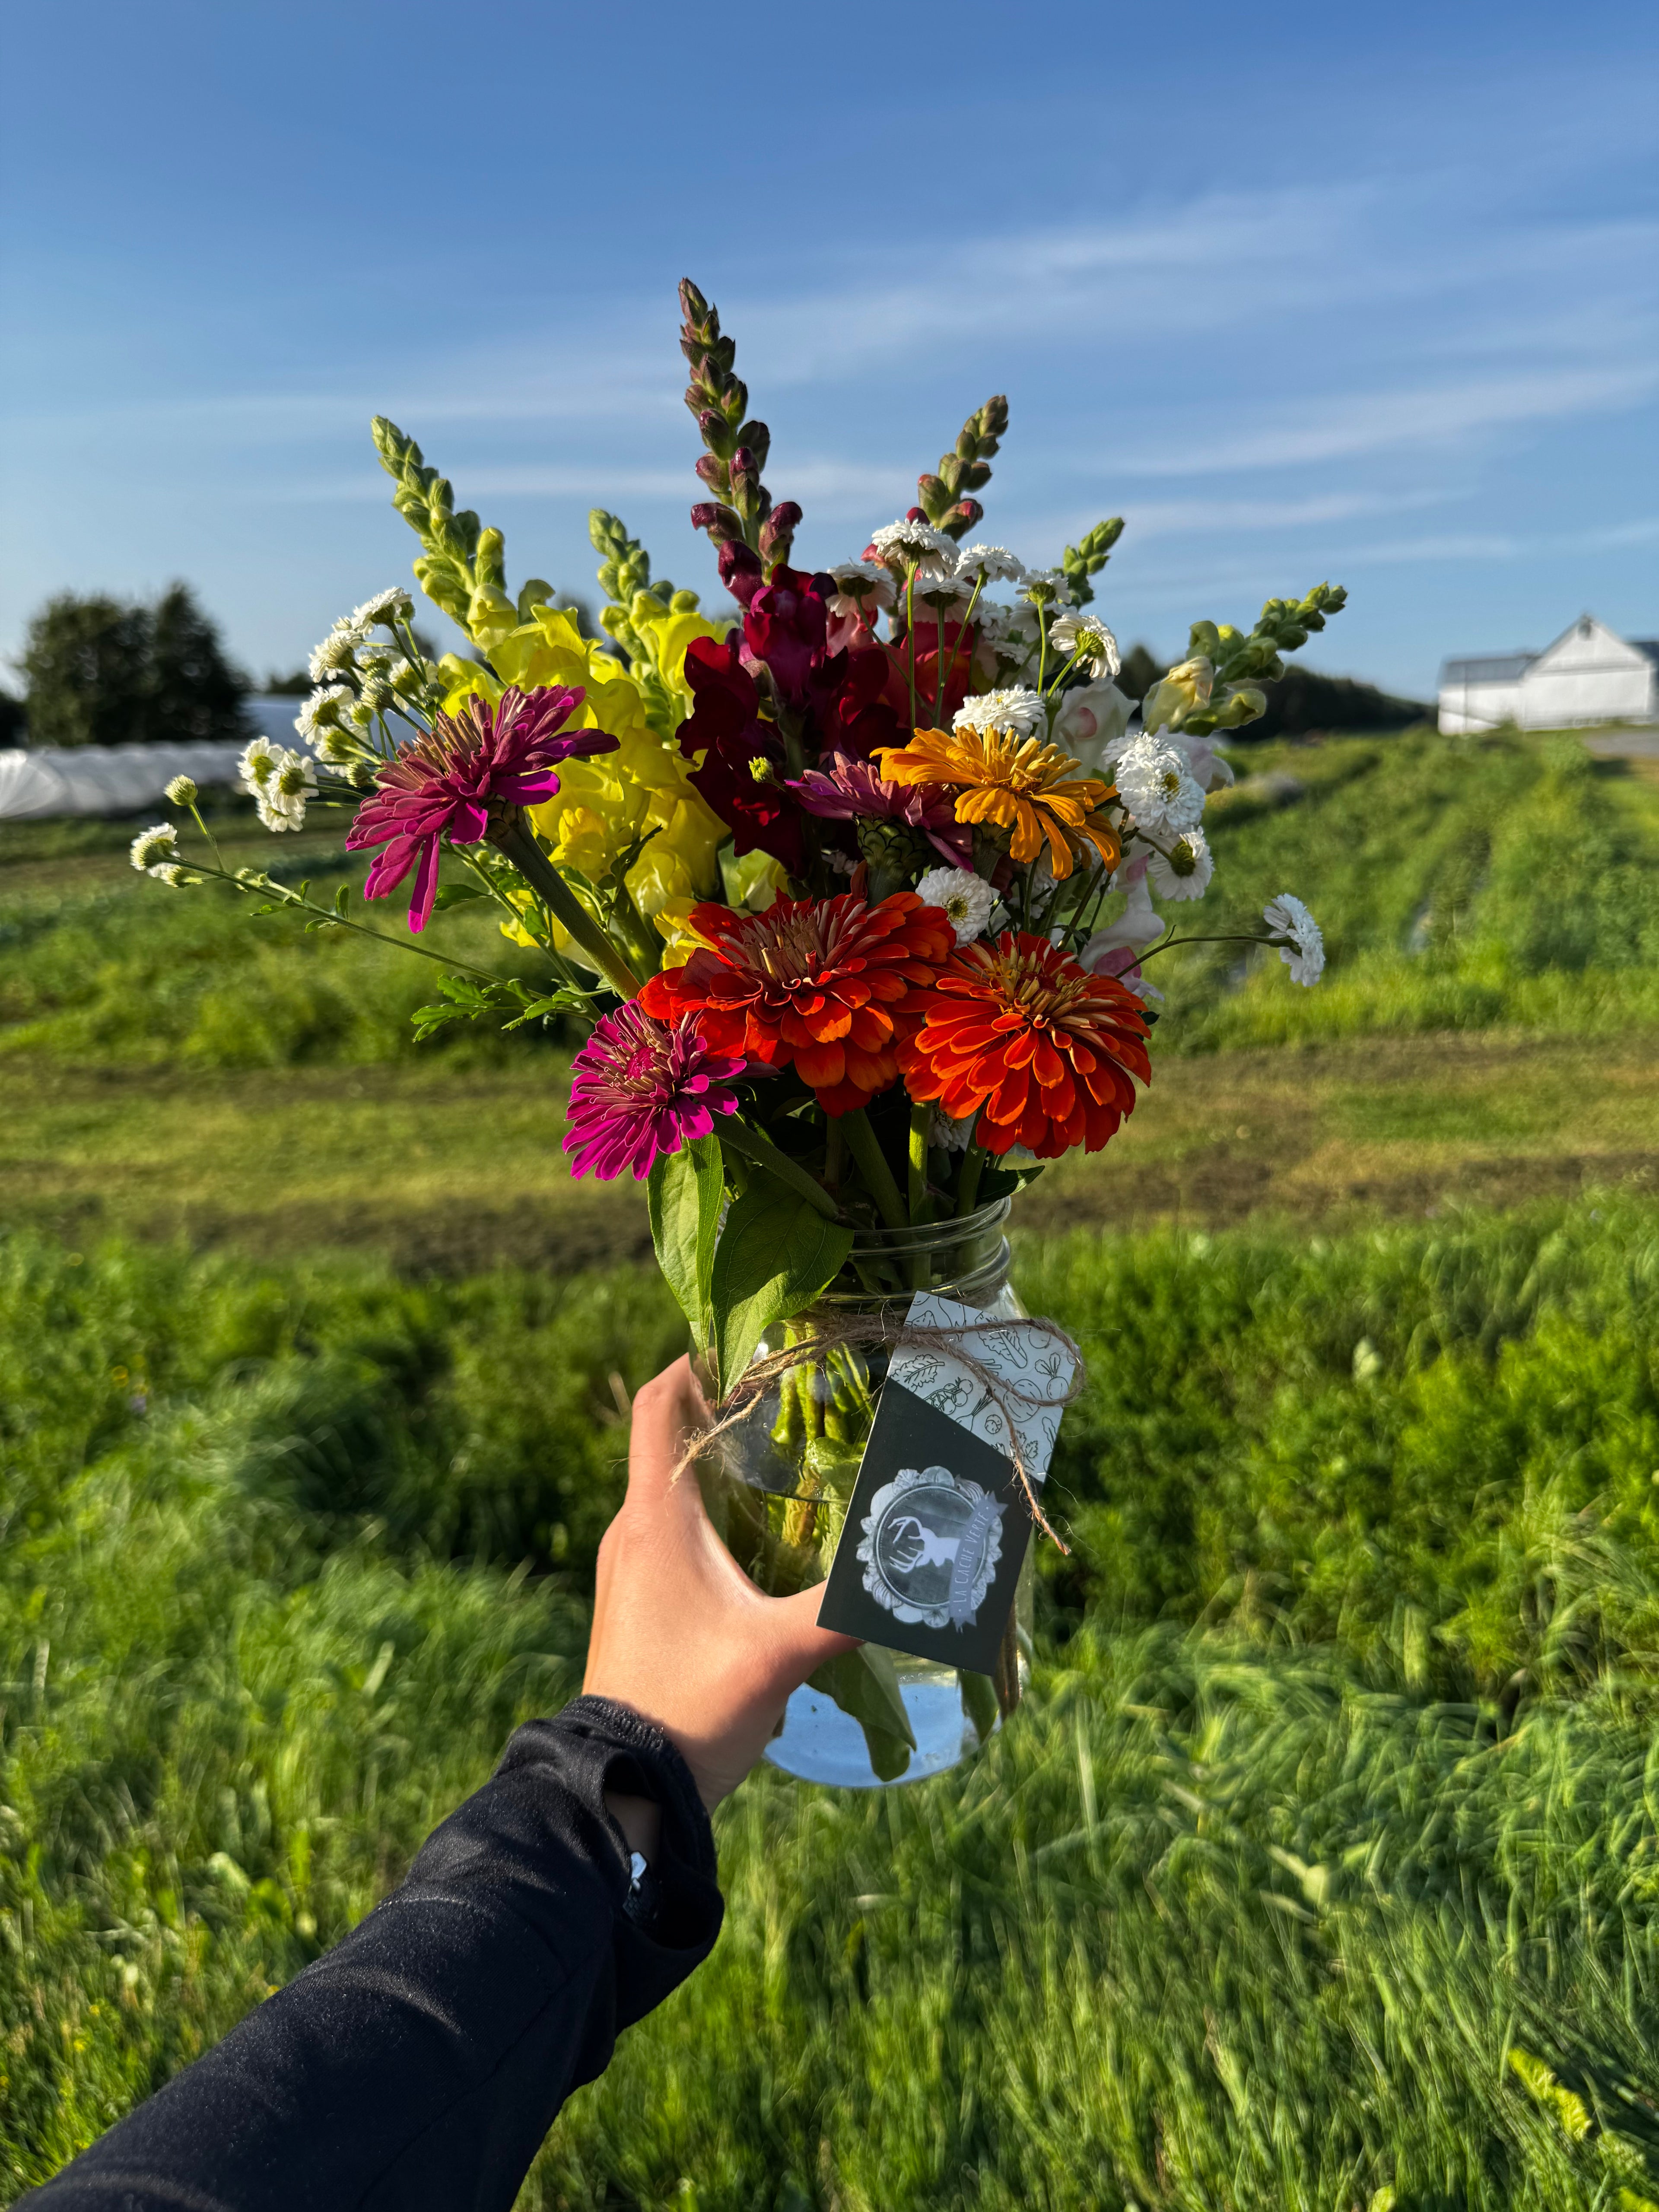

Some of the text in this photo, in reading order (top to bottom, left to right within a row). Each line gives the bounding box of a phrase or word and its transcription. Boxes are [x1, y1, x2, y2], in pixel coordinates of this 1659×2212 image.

[953, 1512, 988, 1602] LA CACHE VERTE
